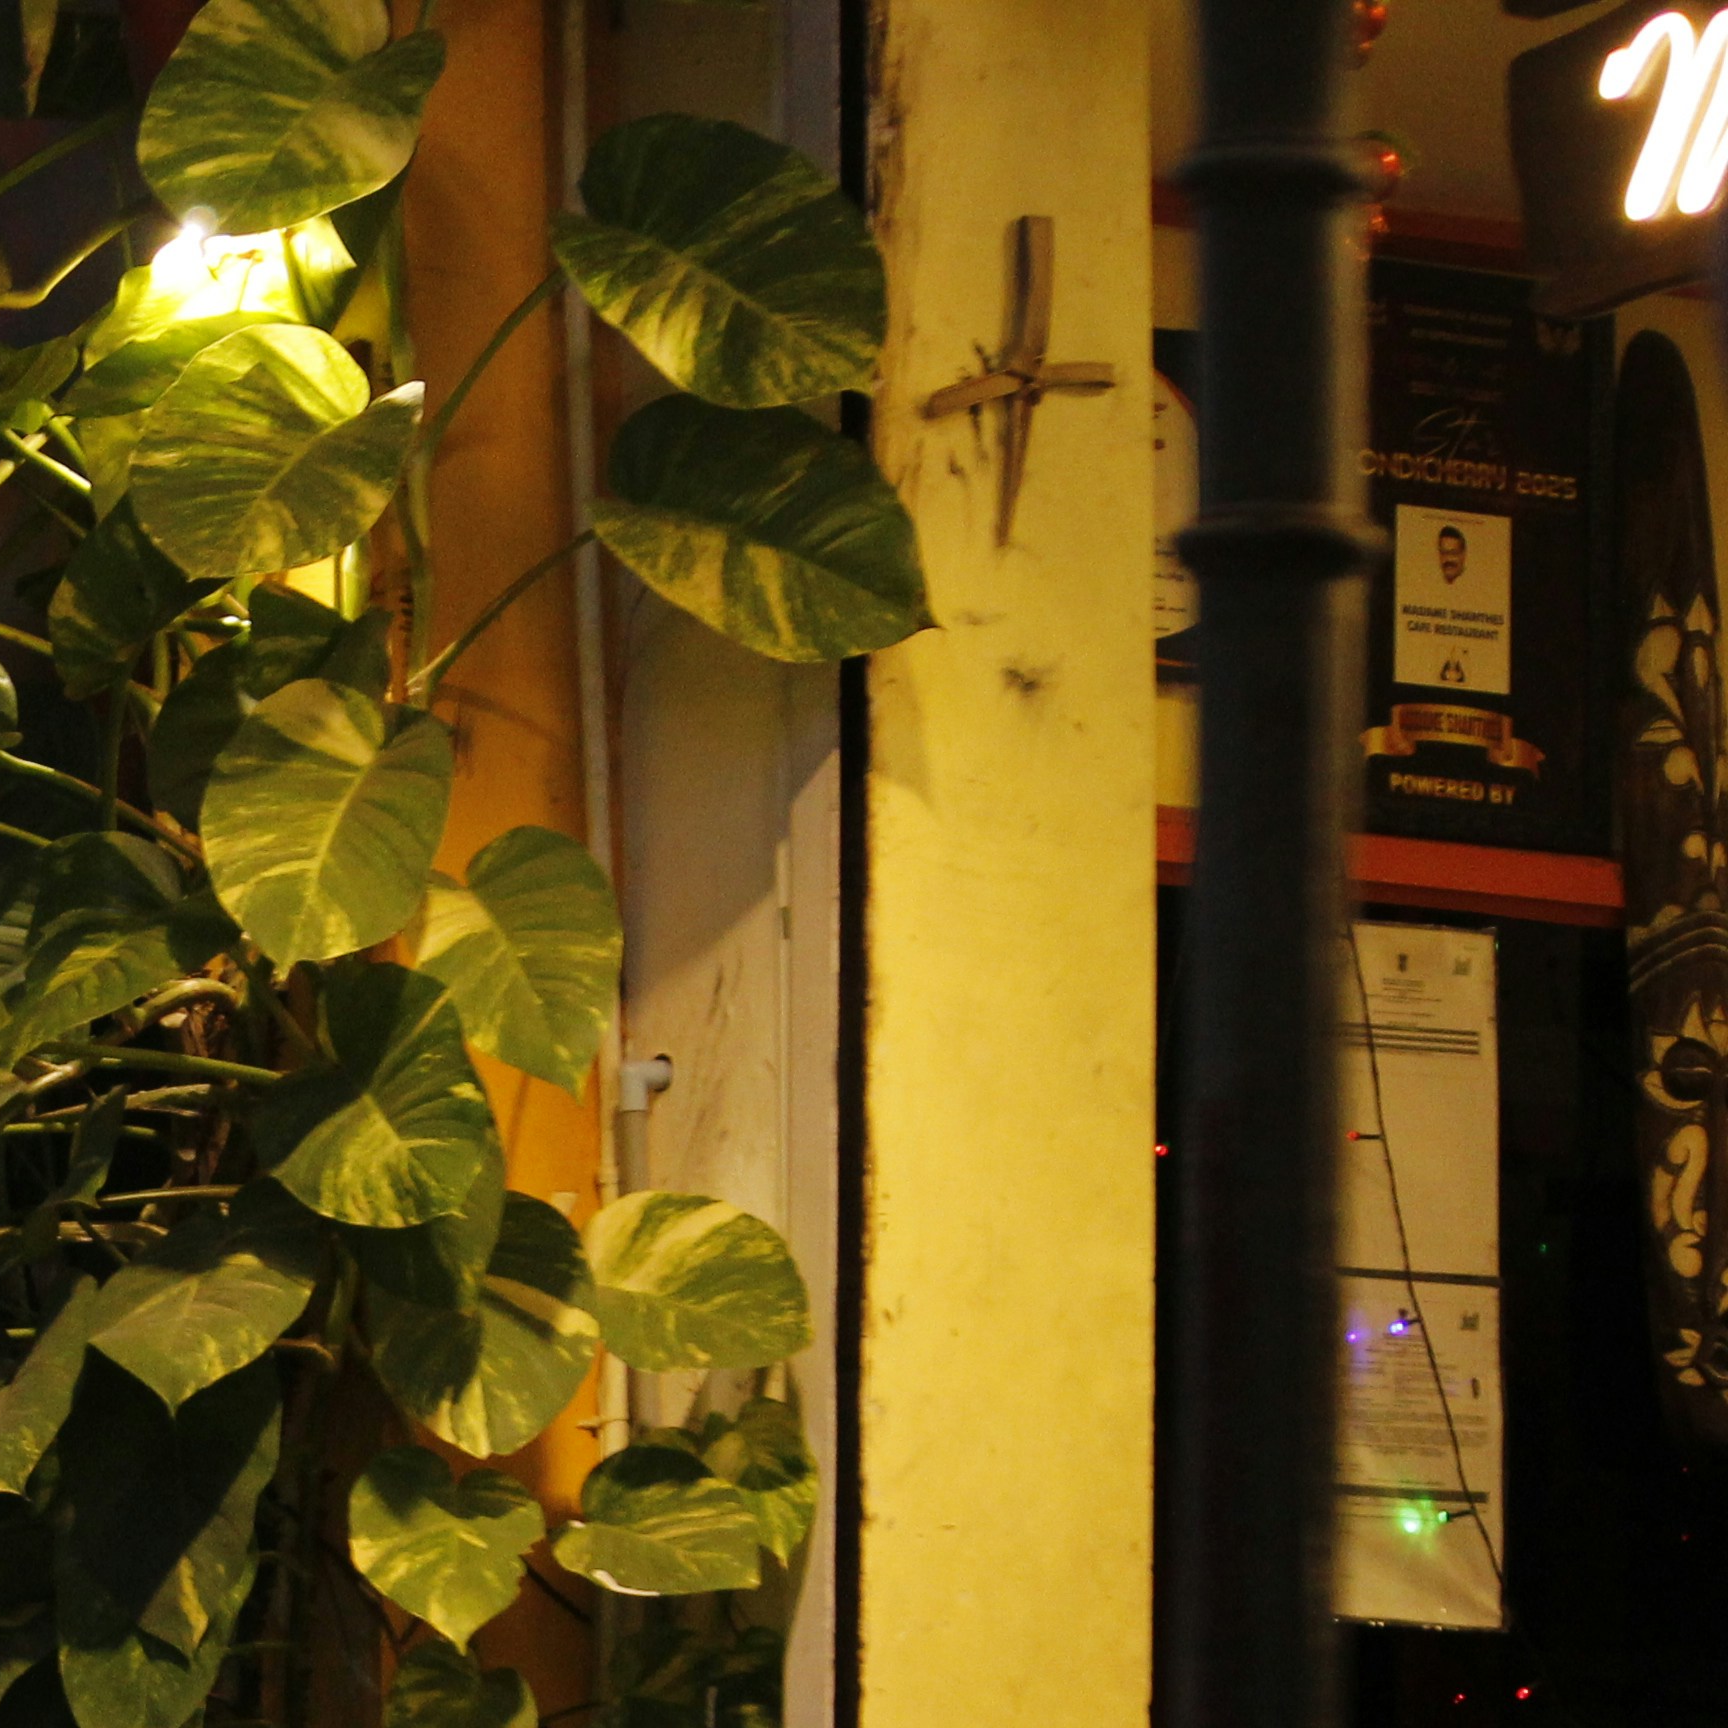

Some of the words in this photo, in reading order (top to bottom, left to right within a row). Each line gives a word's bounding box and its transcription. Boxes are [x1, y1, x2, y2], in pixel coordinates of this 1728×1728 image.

[1357, 448, 1509, 491] ONDICHERRY
[1515, 470, 1578, 500] 2025
[1390, 773, 1485, 802] POWERED
[1489, 783, 1515, 806] BY
